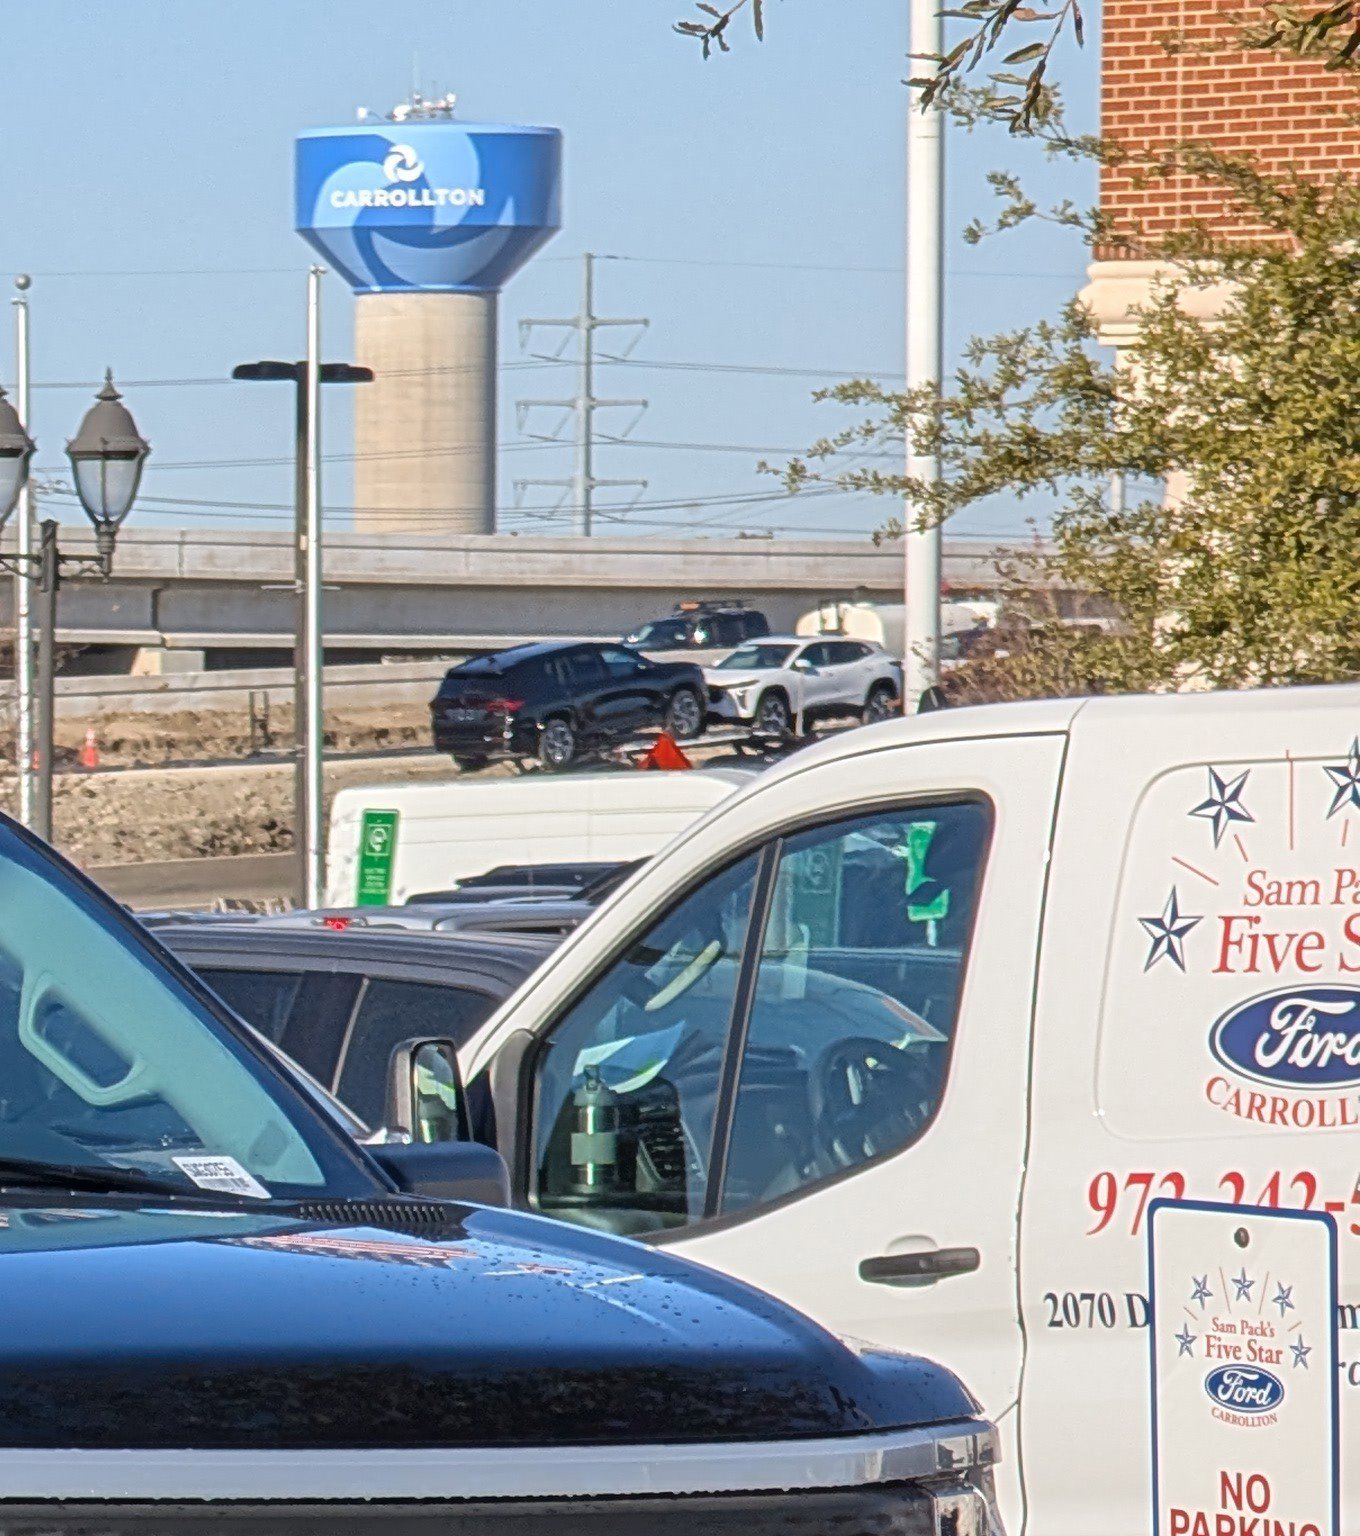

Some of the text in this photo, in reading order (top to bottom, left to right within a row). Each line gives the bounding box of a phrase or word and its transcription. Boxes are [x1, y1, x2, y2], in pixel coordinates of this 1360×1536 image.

[330, 188, 485, 207] CARROLLTON
[1244, 869, 1321, 908] Sam
[1212, 915, 1326, 974] Five
[1205, 1075, 1360, 1129] CARROLL
[1042, 1292, 1117, 1329] 2070
[1211, 1317, 1276, 1338] Sam Pack's
[1204, 1334, 1284, 1365] Five Star
[1218, 1370, 1274, 1405] Ford
[1211, 1406, 1278, 1428] CARROLLTON
[1220, 1470, 1272, 1515] NO
